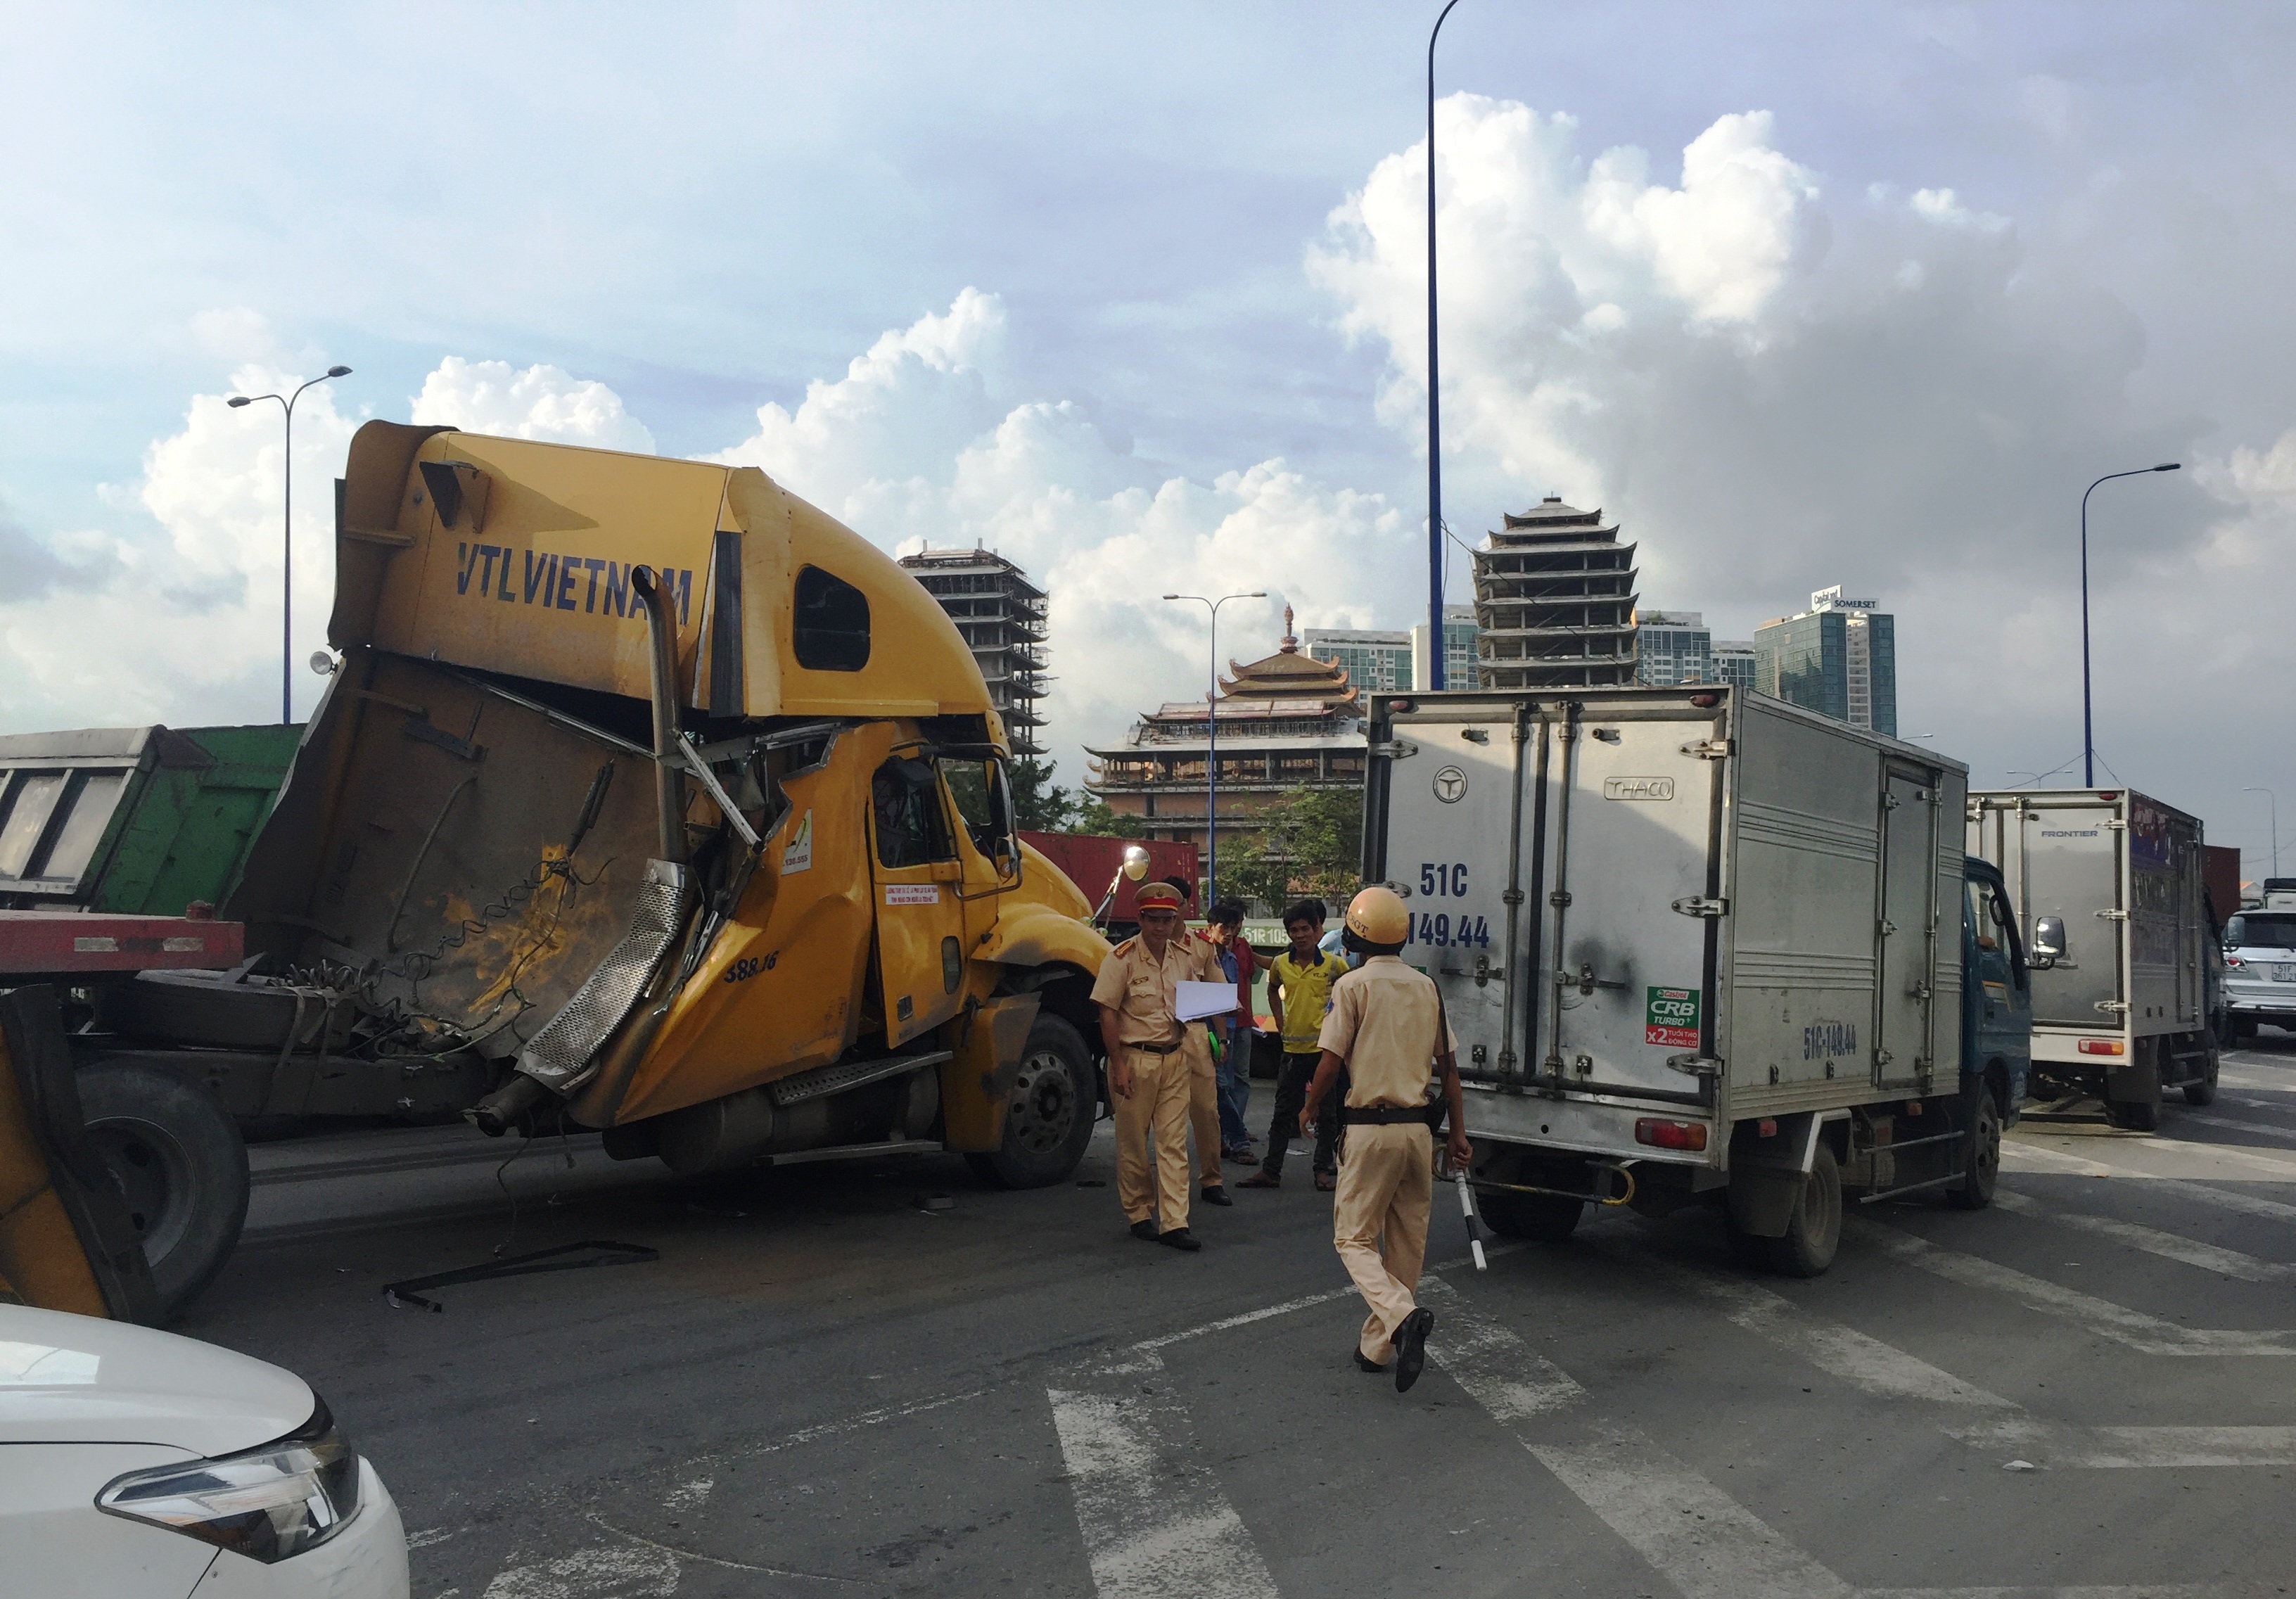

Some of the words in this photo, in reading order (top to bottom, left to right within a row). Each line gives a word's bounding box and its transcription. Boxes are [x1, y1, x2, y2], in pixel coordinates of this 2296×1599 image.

[1835, 599, 1876, 609] SOMERSET
[1606, 779, 1671, 797] THACO
[1420, 862, 1468, 898] 51C
[1244, 927, 1266, 943] 51R
[1408, 912, 1490, 949] 149.44
[2278, 964, 2292, 973] 51F
[1650, 1000, 1695, 1017] CRB
[1647, 1028, 1668, 1044] x2
[1804, 1024, 1857, 1061] 51C-149.44
